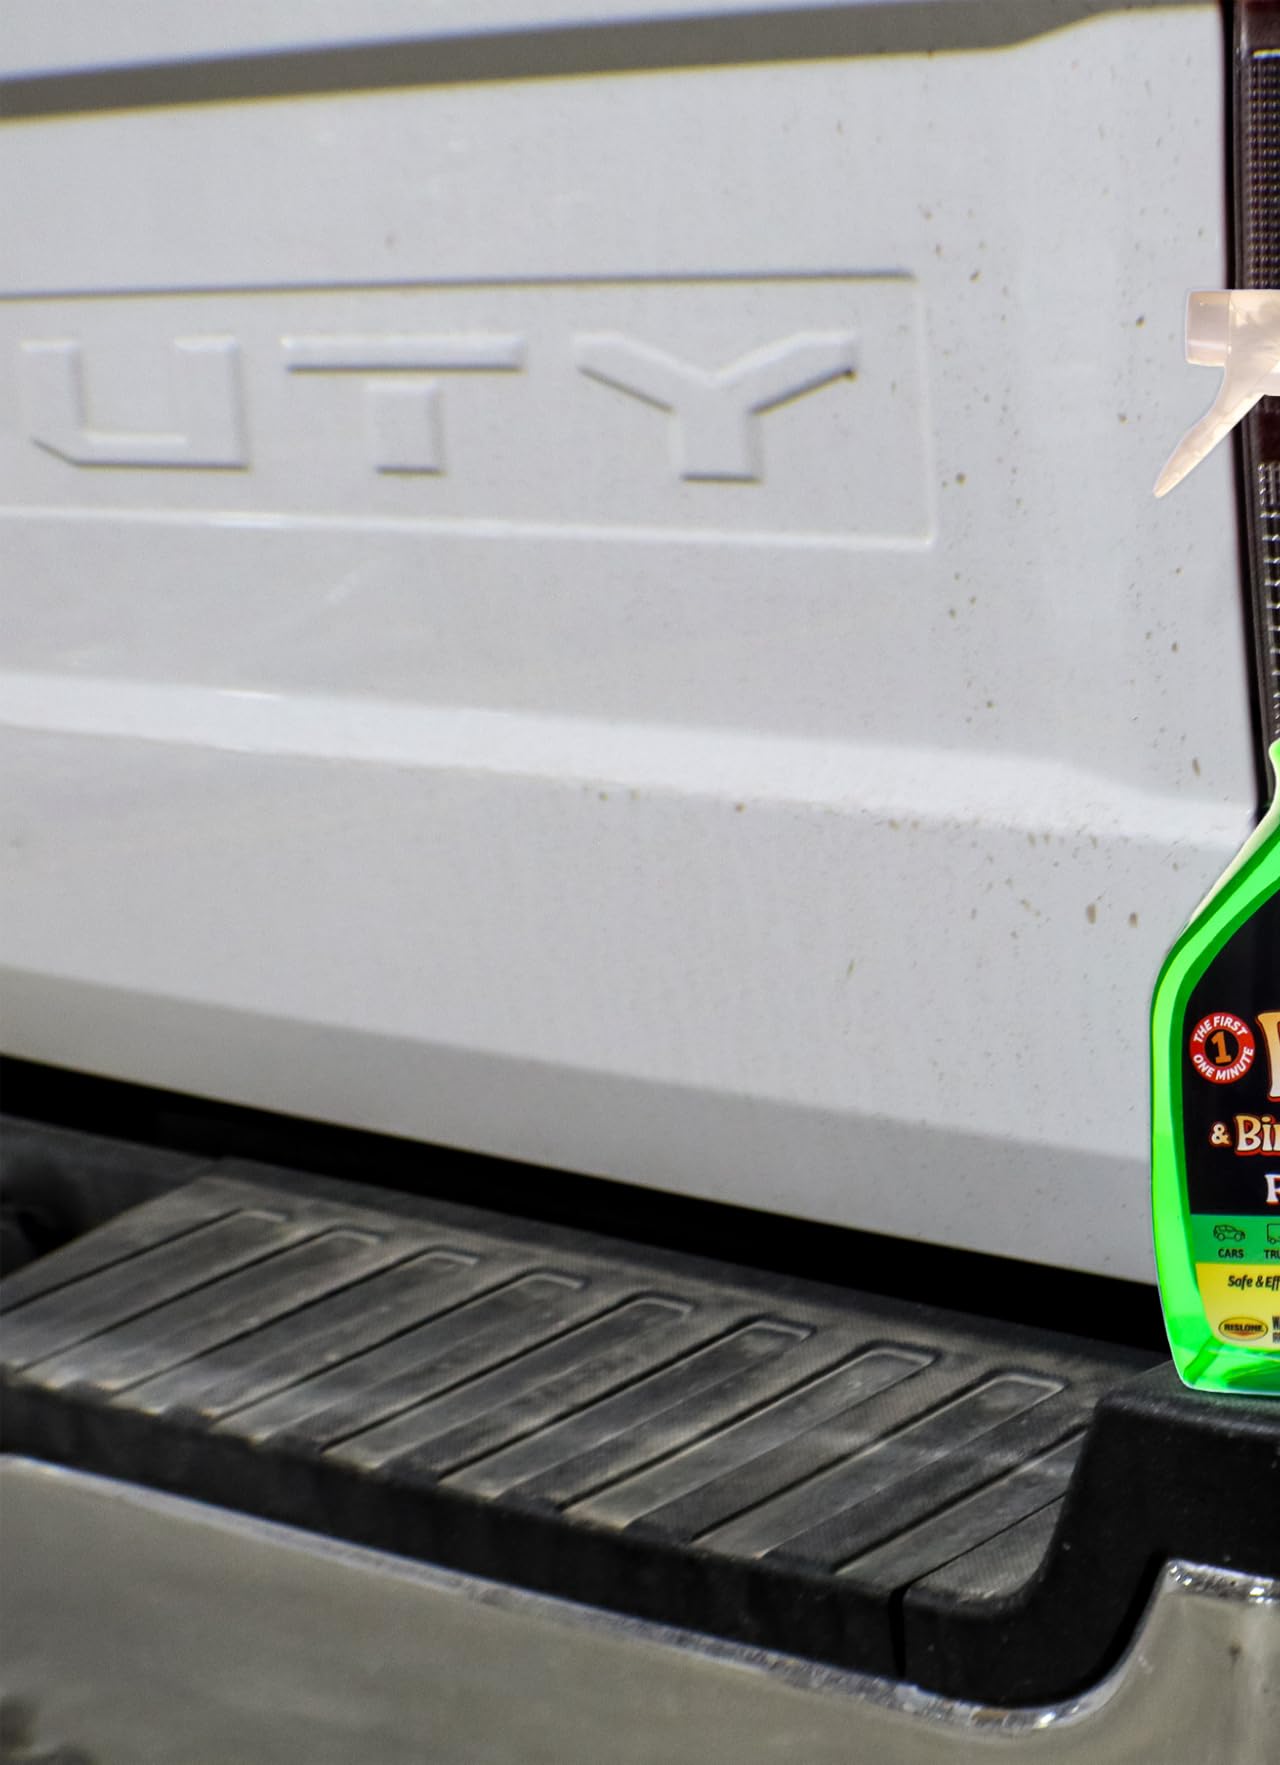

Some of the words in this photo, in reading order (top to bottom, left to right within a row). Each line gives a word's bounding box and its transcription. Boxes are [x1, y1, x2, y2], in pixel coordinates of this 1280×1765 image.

[1193, 1019, 1212, 1043] THE
[1213, 1016, 1248, 1035] FIRST
[1211, 1031, 1232, 1064] 1
[1193, 1054, 1215, 1077] ONE
[1215, 1046, 1254, 1080] MINUTE
[1210, 1122, 1231, 1146] &
[1218, 1248, 1244, 1259] CARS
[1228, 1275, 1253, 1290] Safe
[1255, 1275, 1264, 1288] &
